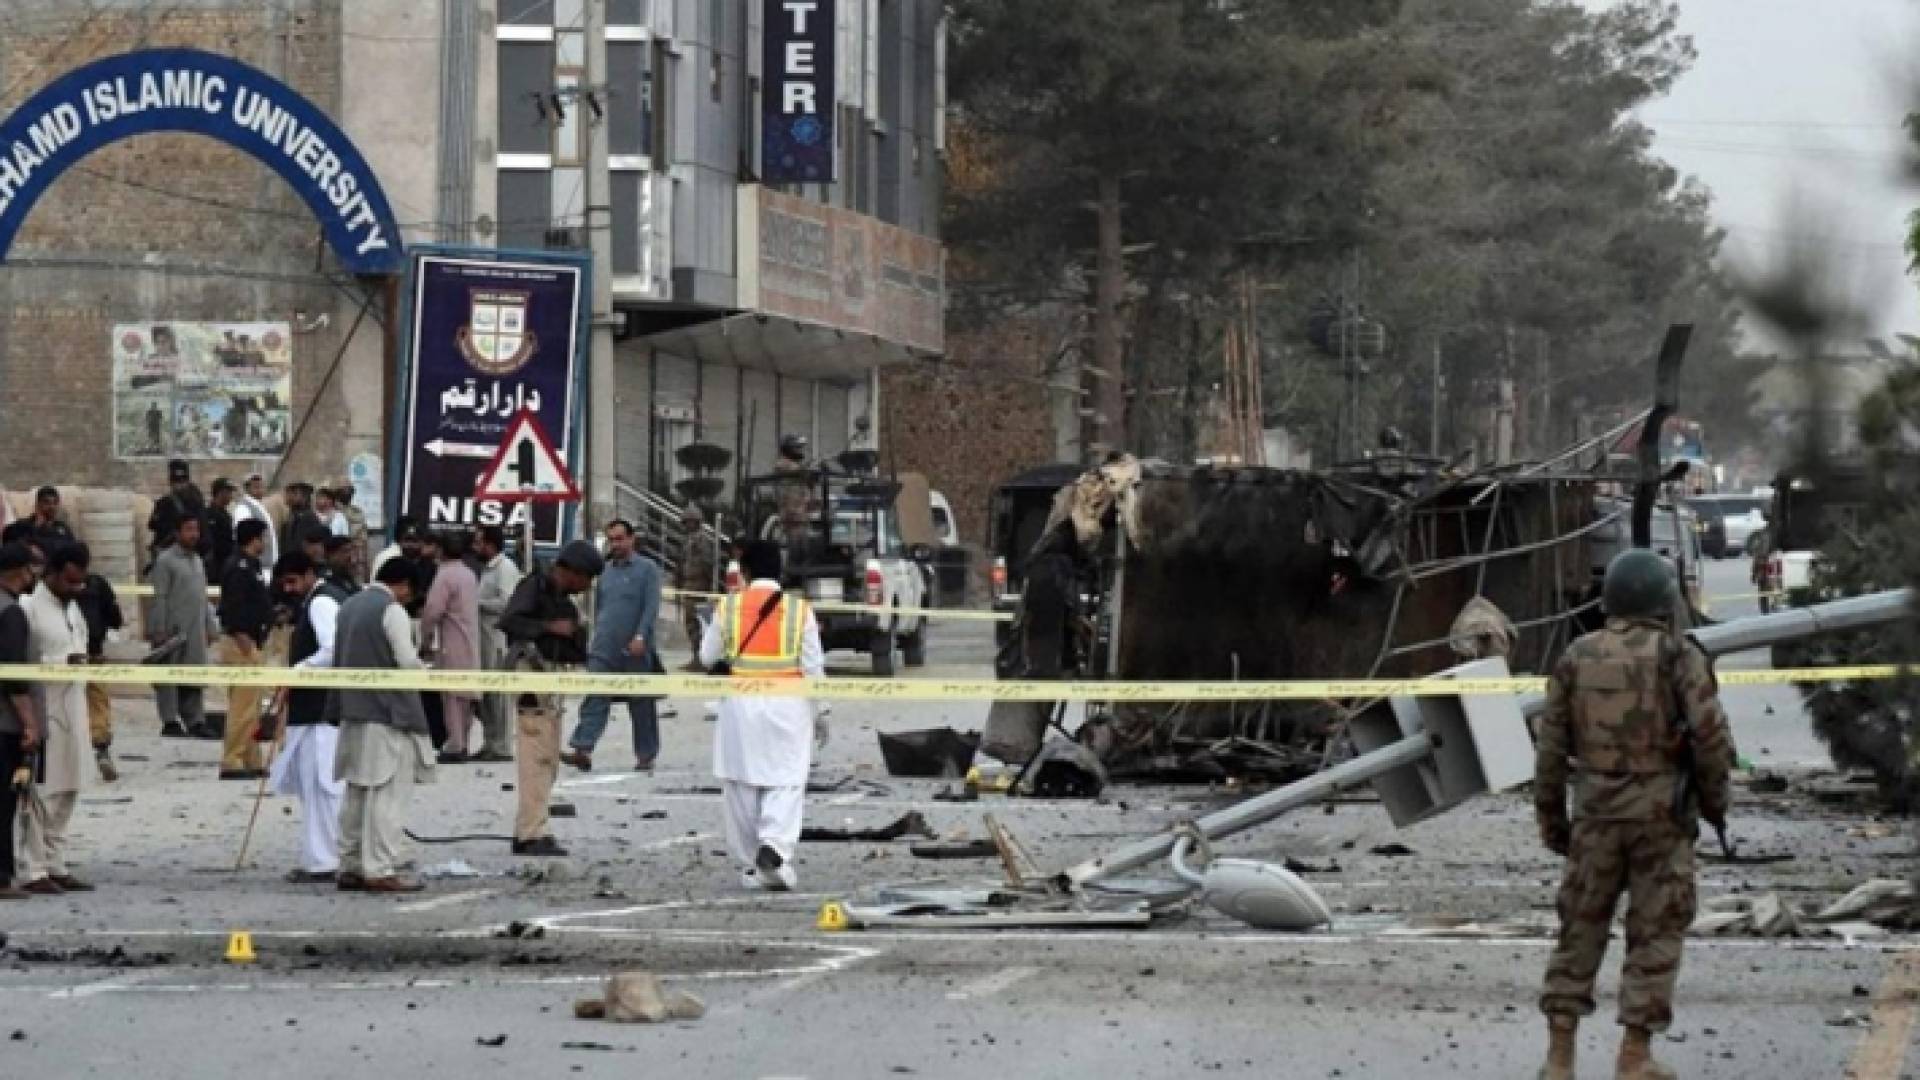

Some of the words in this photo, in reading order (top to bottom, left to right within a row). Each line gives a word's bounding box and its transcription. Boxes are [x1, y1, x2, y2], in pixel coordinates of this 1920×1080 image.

[782, 2, 818, 114] TER
[81, 69, 226, 126] ISLAMIC
[231, 86, 388, 255] UNIVERSITY
